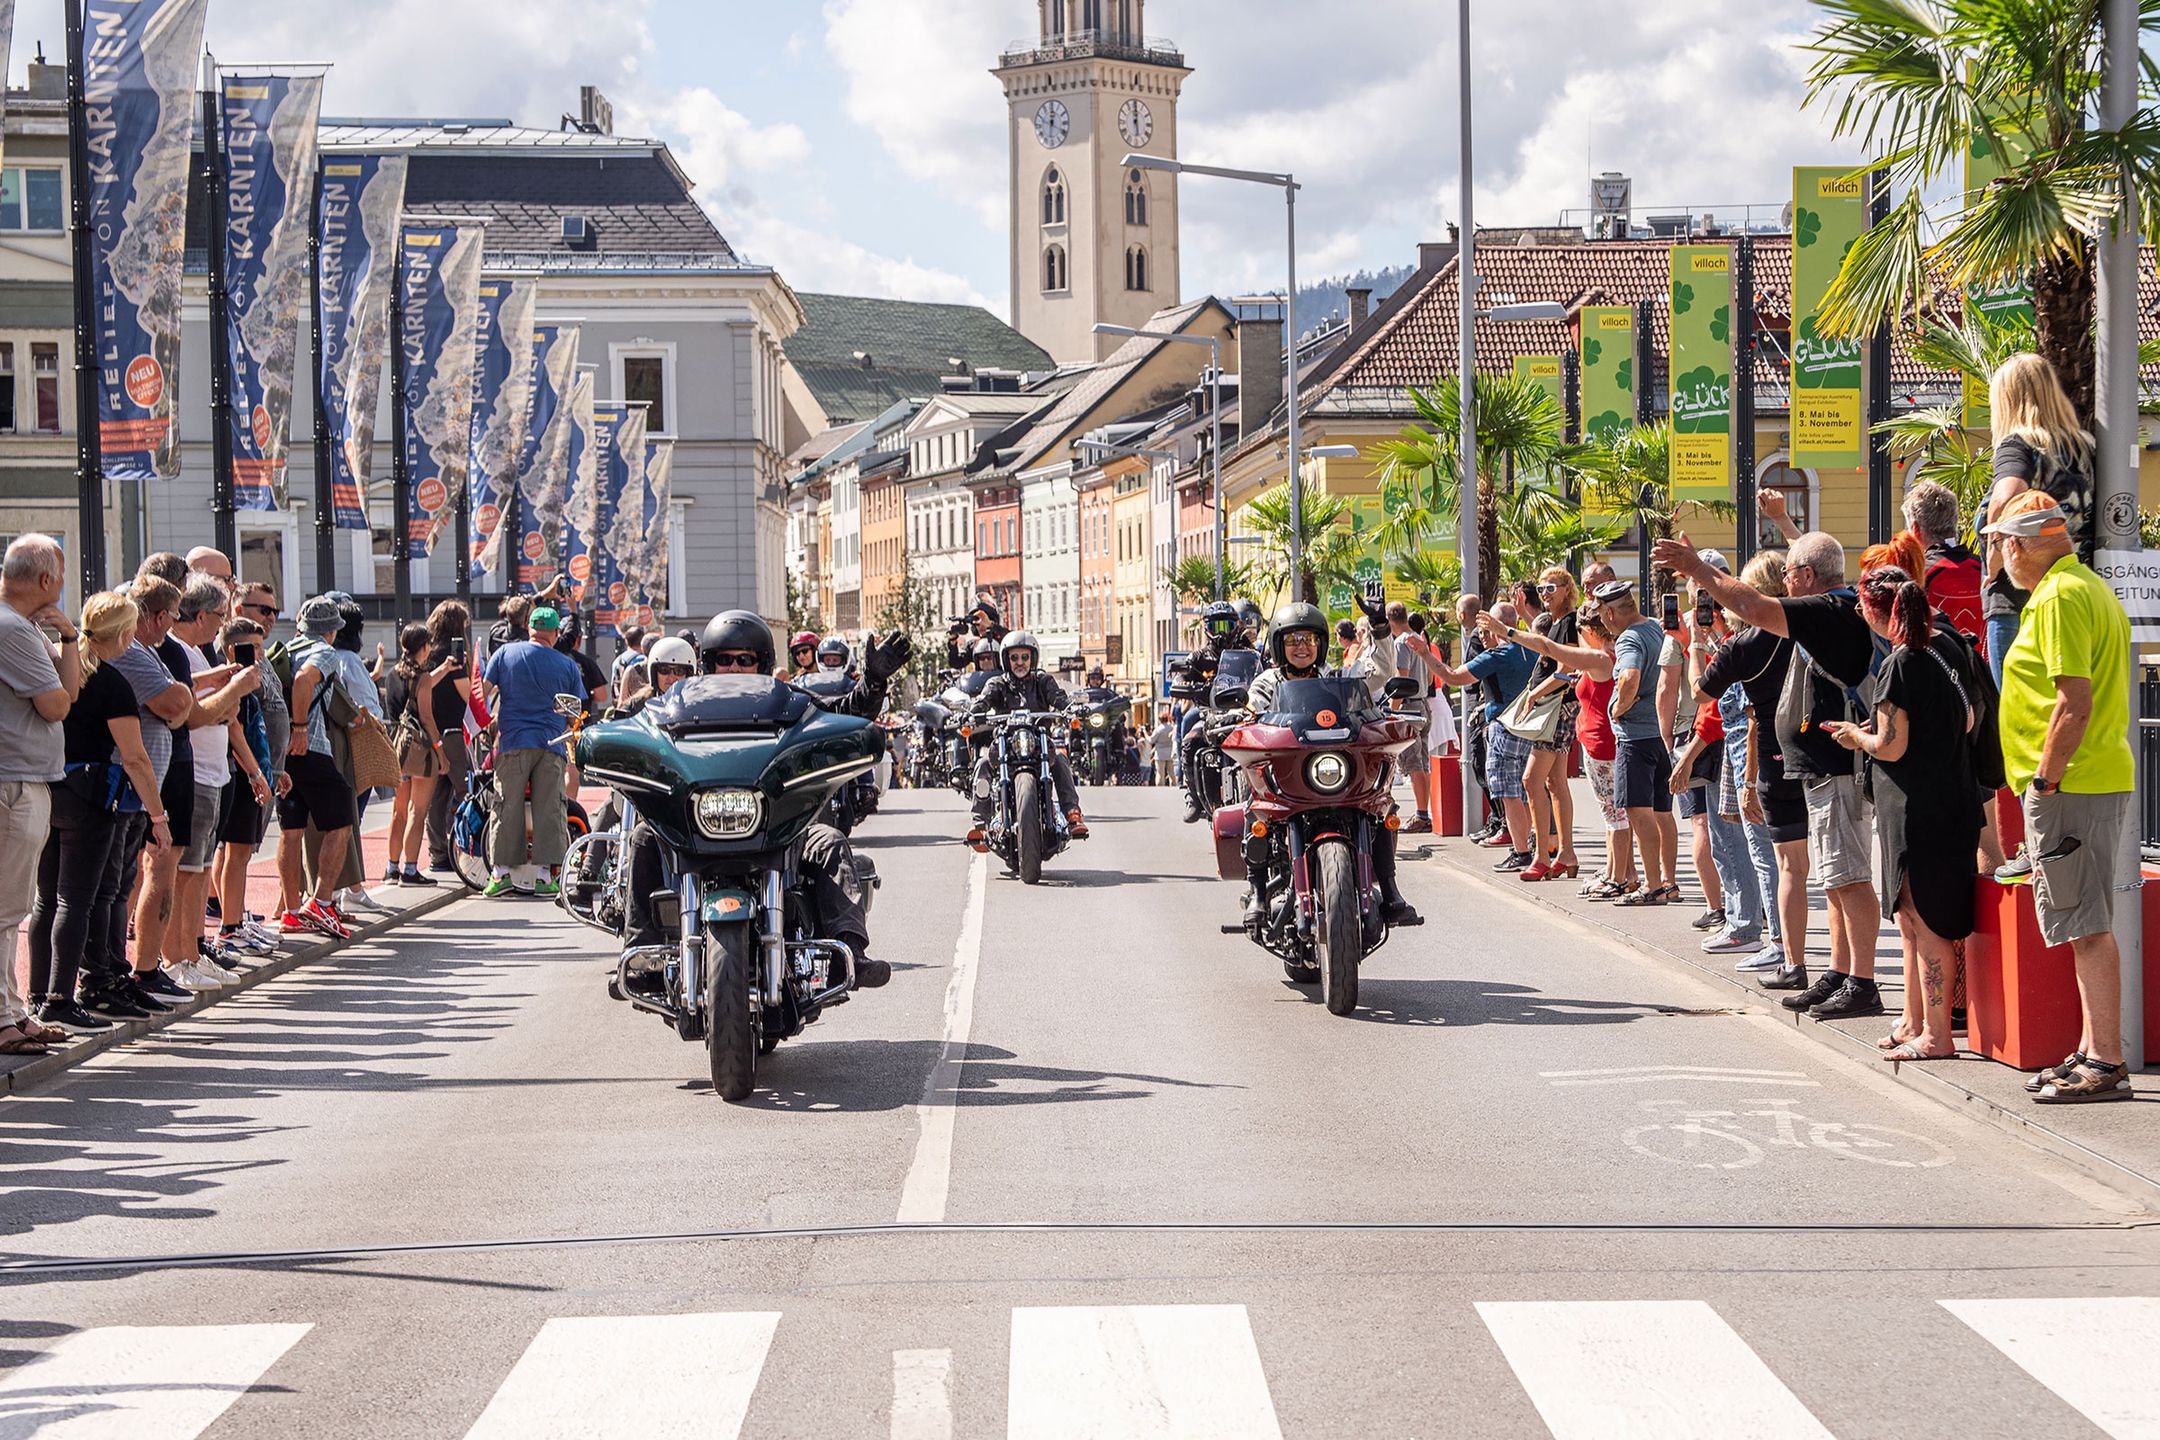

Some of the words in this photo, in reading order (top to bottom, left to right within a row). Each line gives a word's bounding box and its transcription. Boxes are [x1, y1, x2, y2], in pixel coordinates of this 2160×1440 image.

[226, 108, 257, 260] KÄRNTEN
[1822, 181, 1858, 193] villach
[1694, 258, 1726, 268] villach
[402, 251, 432, 366] KÄRNTEN
[1602, 318, 1629, 326] villach
[104, 281, 121, 411] RELIEF
[130, 364, 156, 384] NEU
[1532, 366, 1556, 374] villach
[1672, 383, 1730, 412] GLÜCK
[421, 484, 439, 496] NEU
